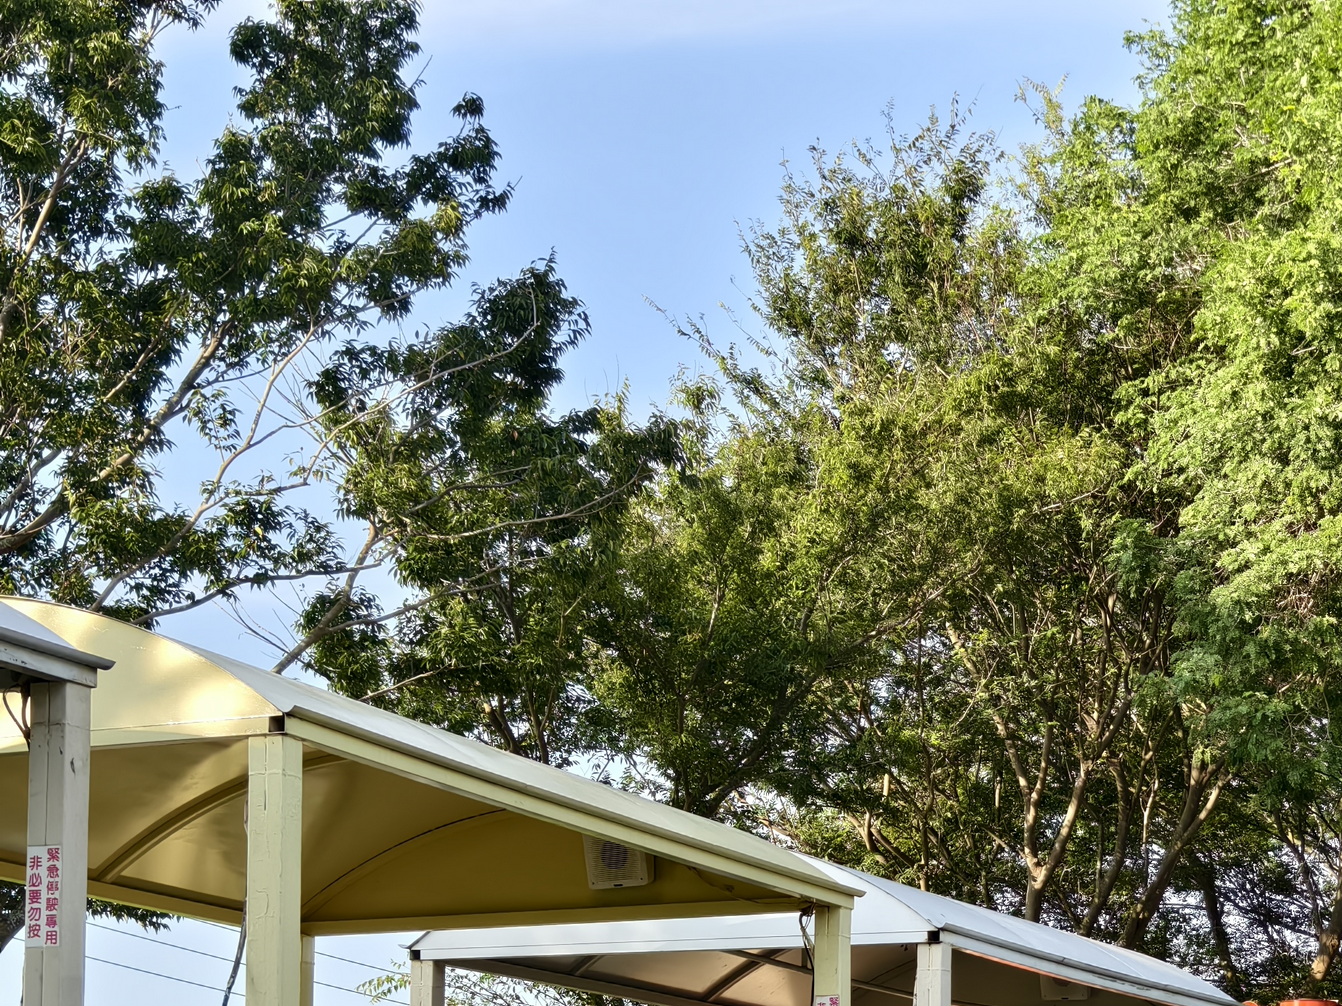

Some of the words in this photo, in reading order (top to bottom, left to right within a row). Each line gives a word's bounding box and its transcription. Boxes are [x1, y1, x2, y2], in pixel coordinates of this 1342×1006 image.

[28, 855, 43, 939] 非必要勿按
[45, 848, 60, 945] 緊急停駛專用
